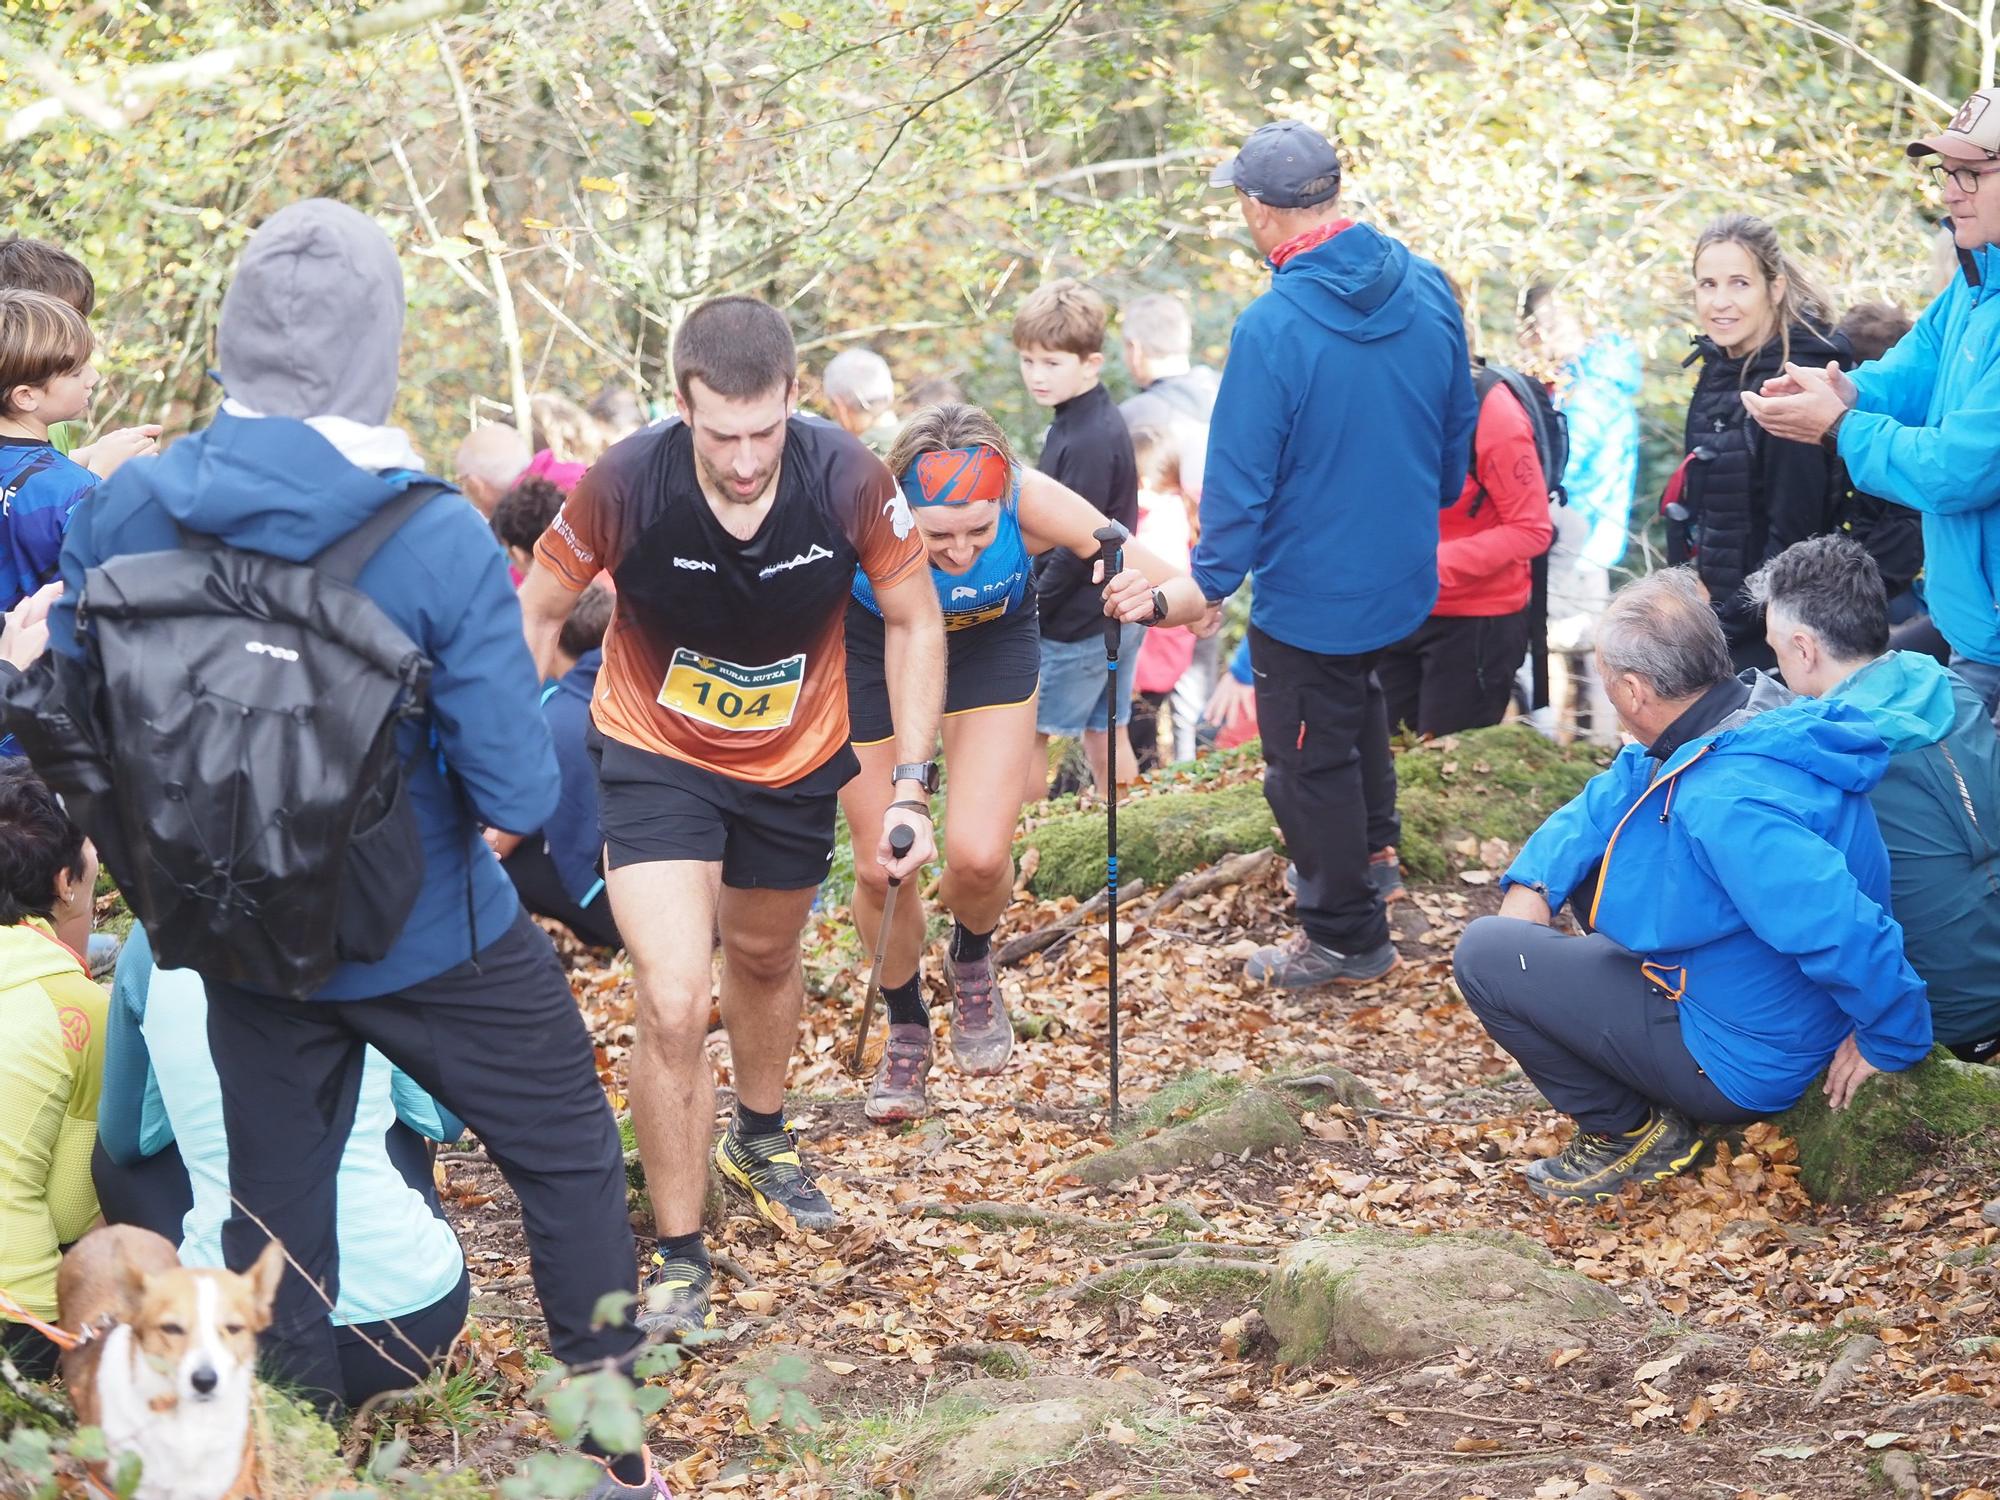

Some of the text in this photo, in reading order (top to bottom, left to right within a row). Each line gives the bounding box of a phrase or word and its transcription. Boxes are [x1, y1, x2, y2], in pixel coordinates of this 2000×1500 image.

[719, 666, 786, 682] RURAL KUTXA
[693, 681, 771, 718] 104
[1615, 1124, 1668, 1173] LA SPORTIVA
